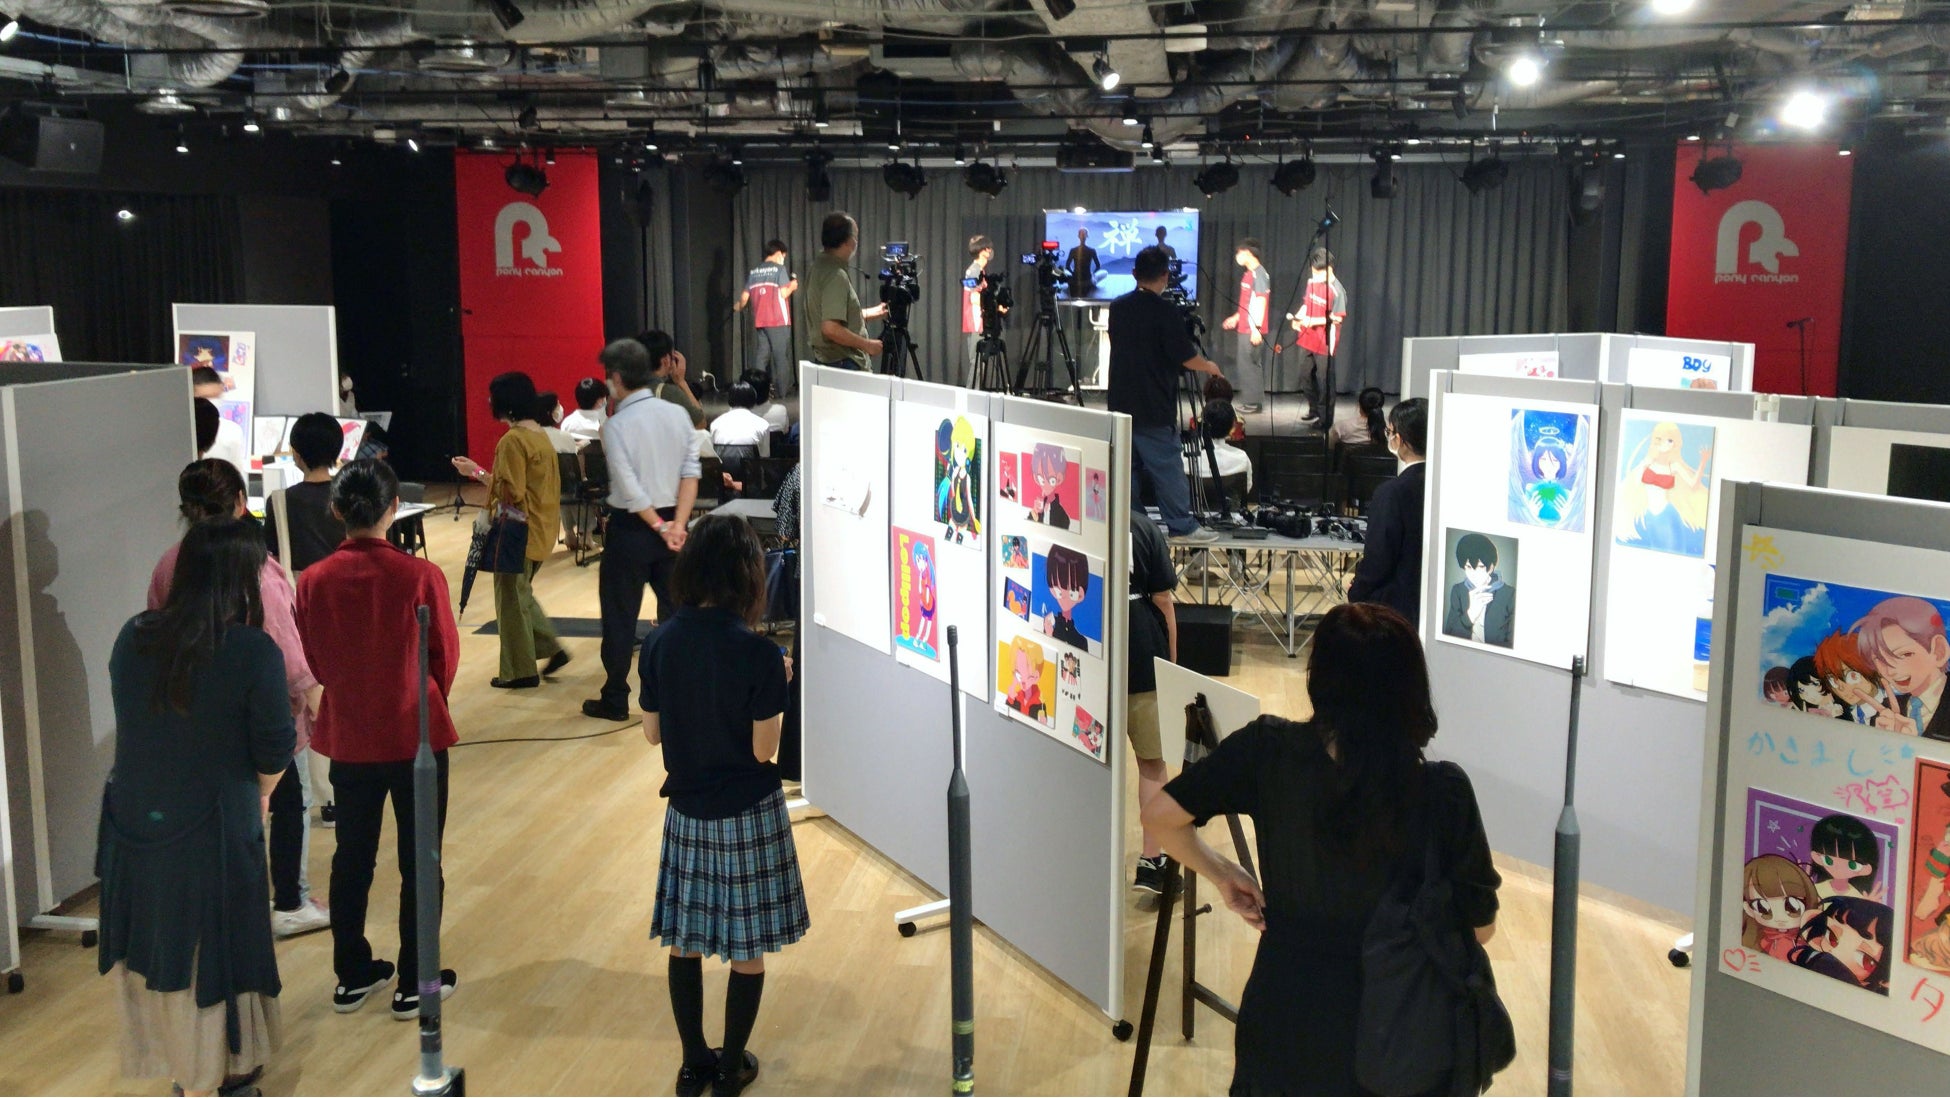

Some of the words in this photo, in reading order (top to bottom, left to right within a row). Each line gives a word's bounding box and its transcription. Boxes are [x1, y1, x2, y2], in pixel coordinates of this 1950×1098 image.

[495, 267, 522, 278] pony
[525, 267, 564, 278] canyon
[1714, 273, 1748, 285] pony
[1750, 273, 1800, 285] canyon
[899, 533, 911, 640] Lollipop
